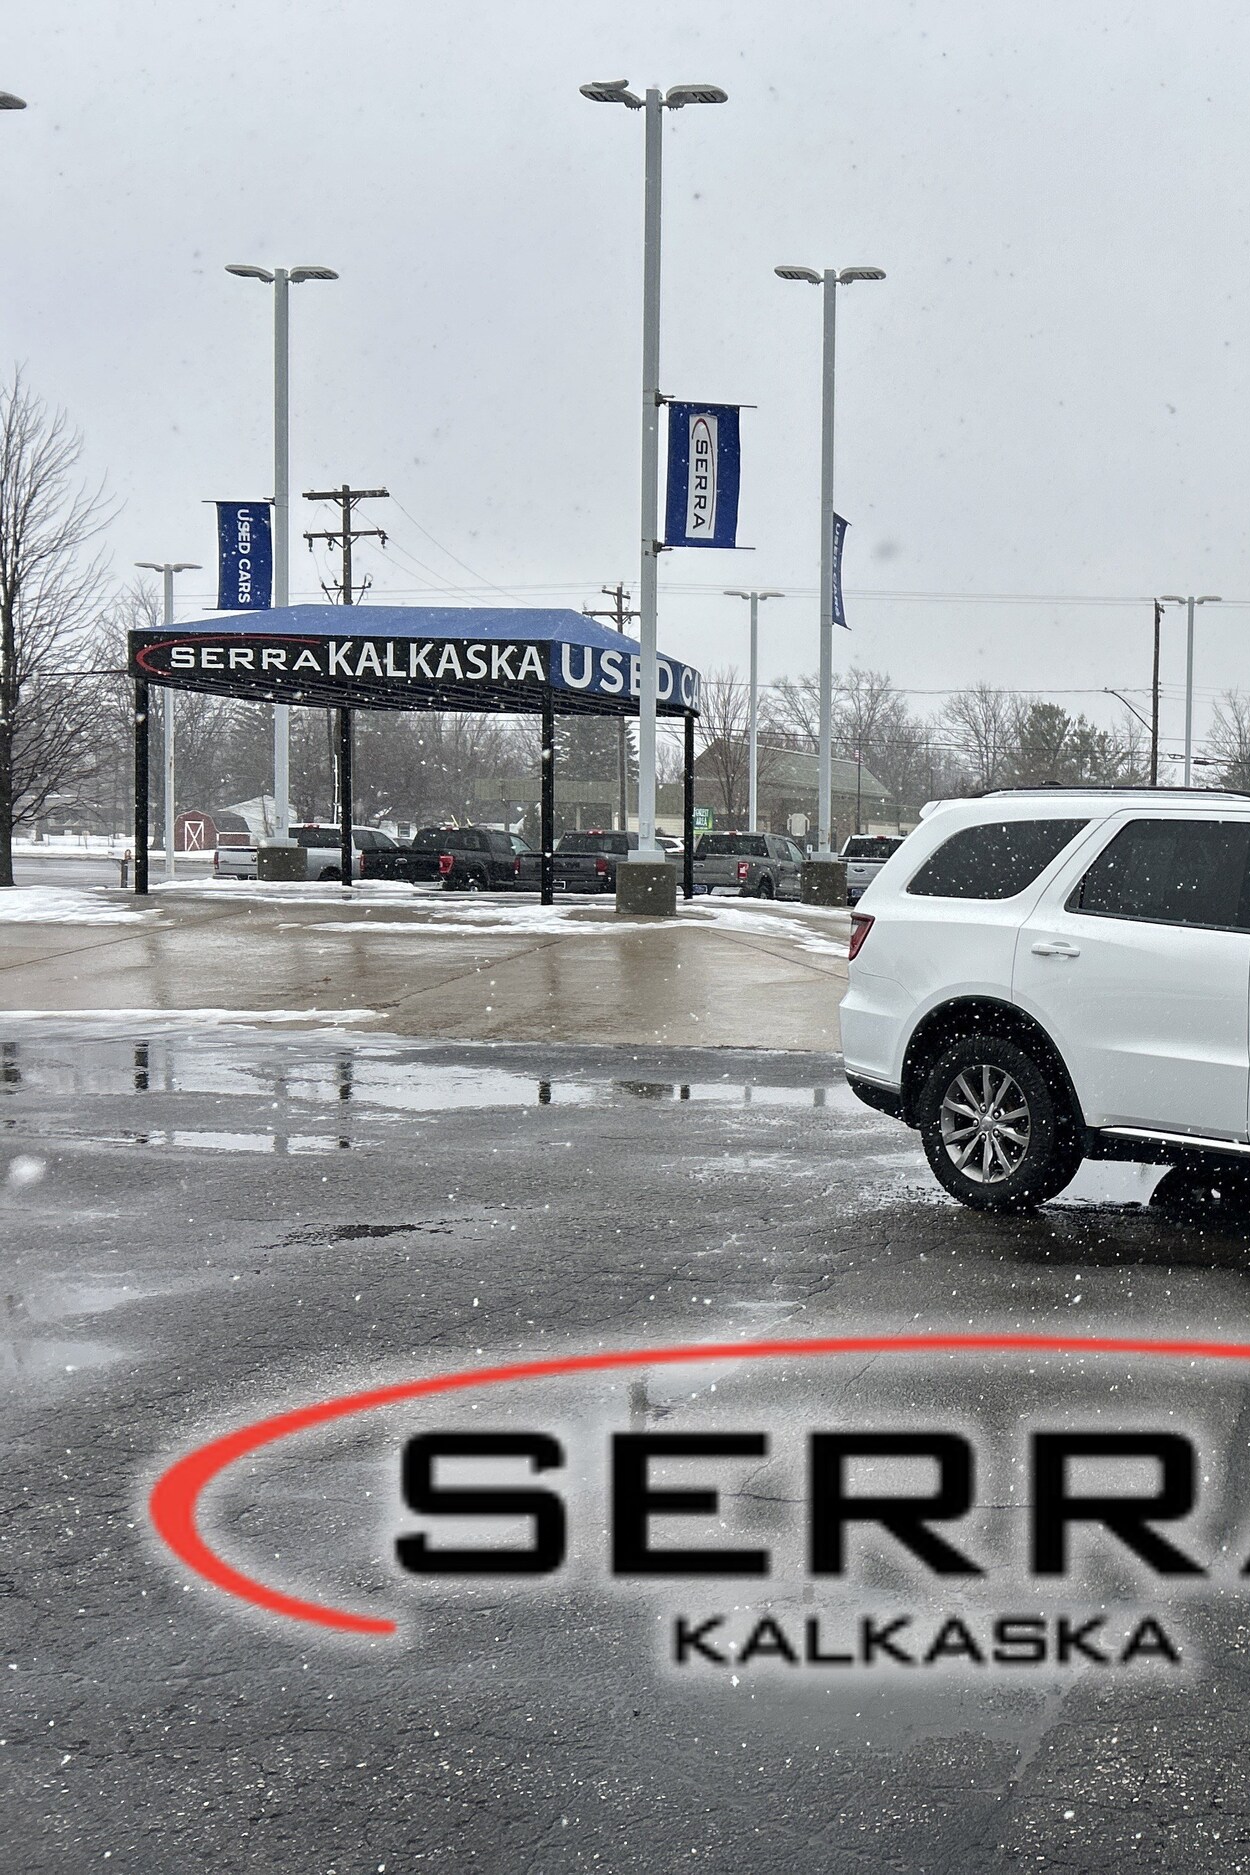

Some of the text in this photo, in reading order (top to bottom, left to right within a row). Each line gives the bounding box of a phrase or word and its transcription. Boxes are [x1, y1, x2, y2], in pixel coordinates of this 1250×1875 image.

[692, 439, 709, 530] SERRA
[237, 508, 252, 604] USED CARS
[170, 640, 546, 682] SERRA KALKASKA
[561, 643, 674, 700] USED
